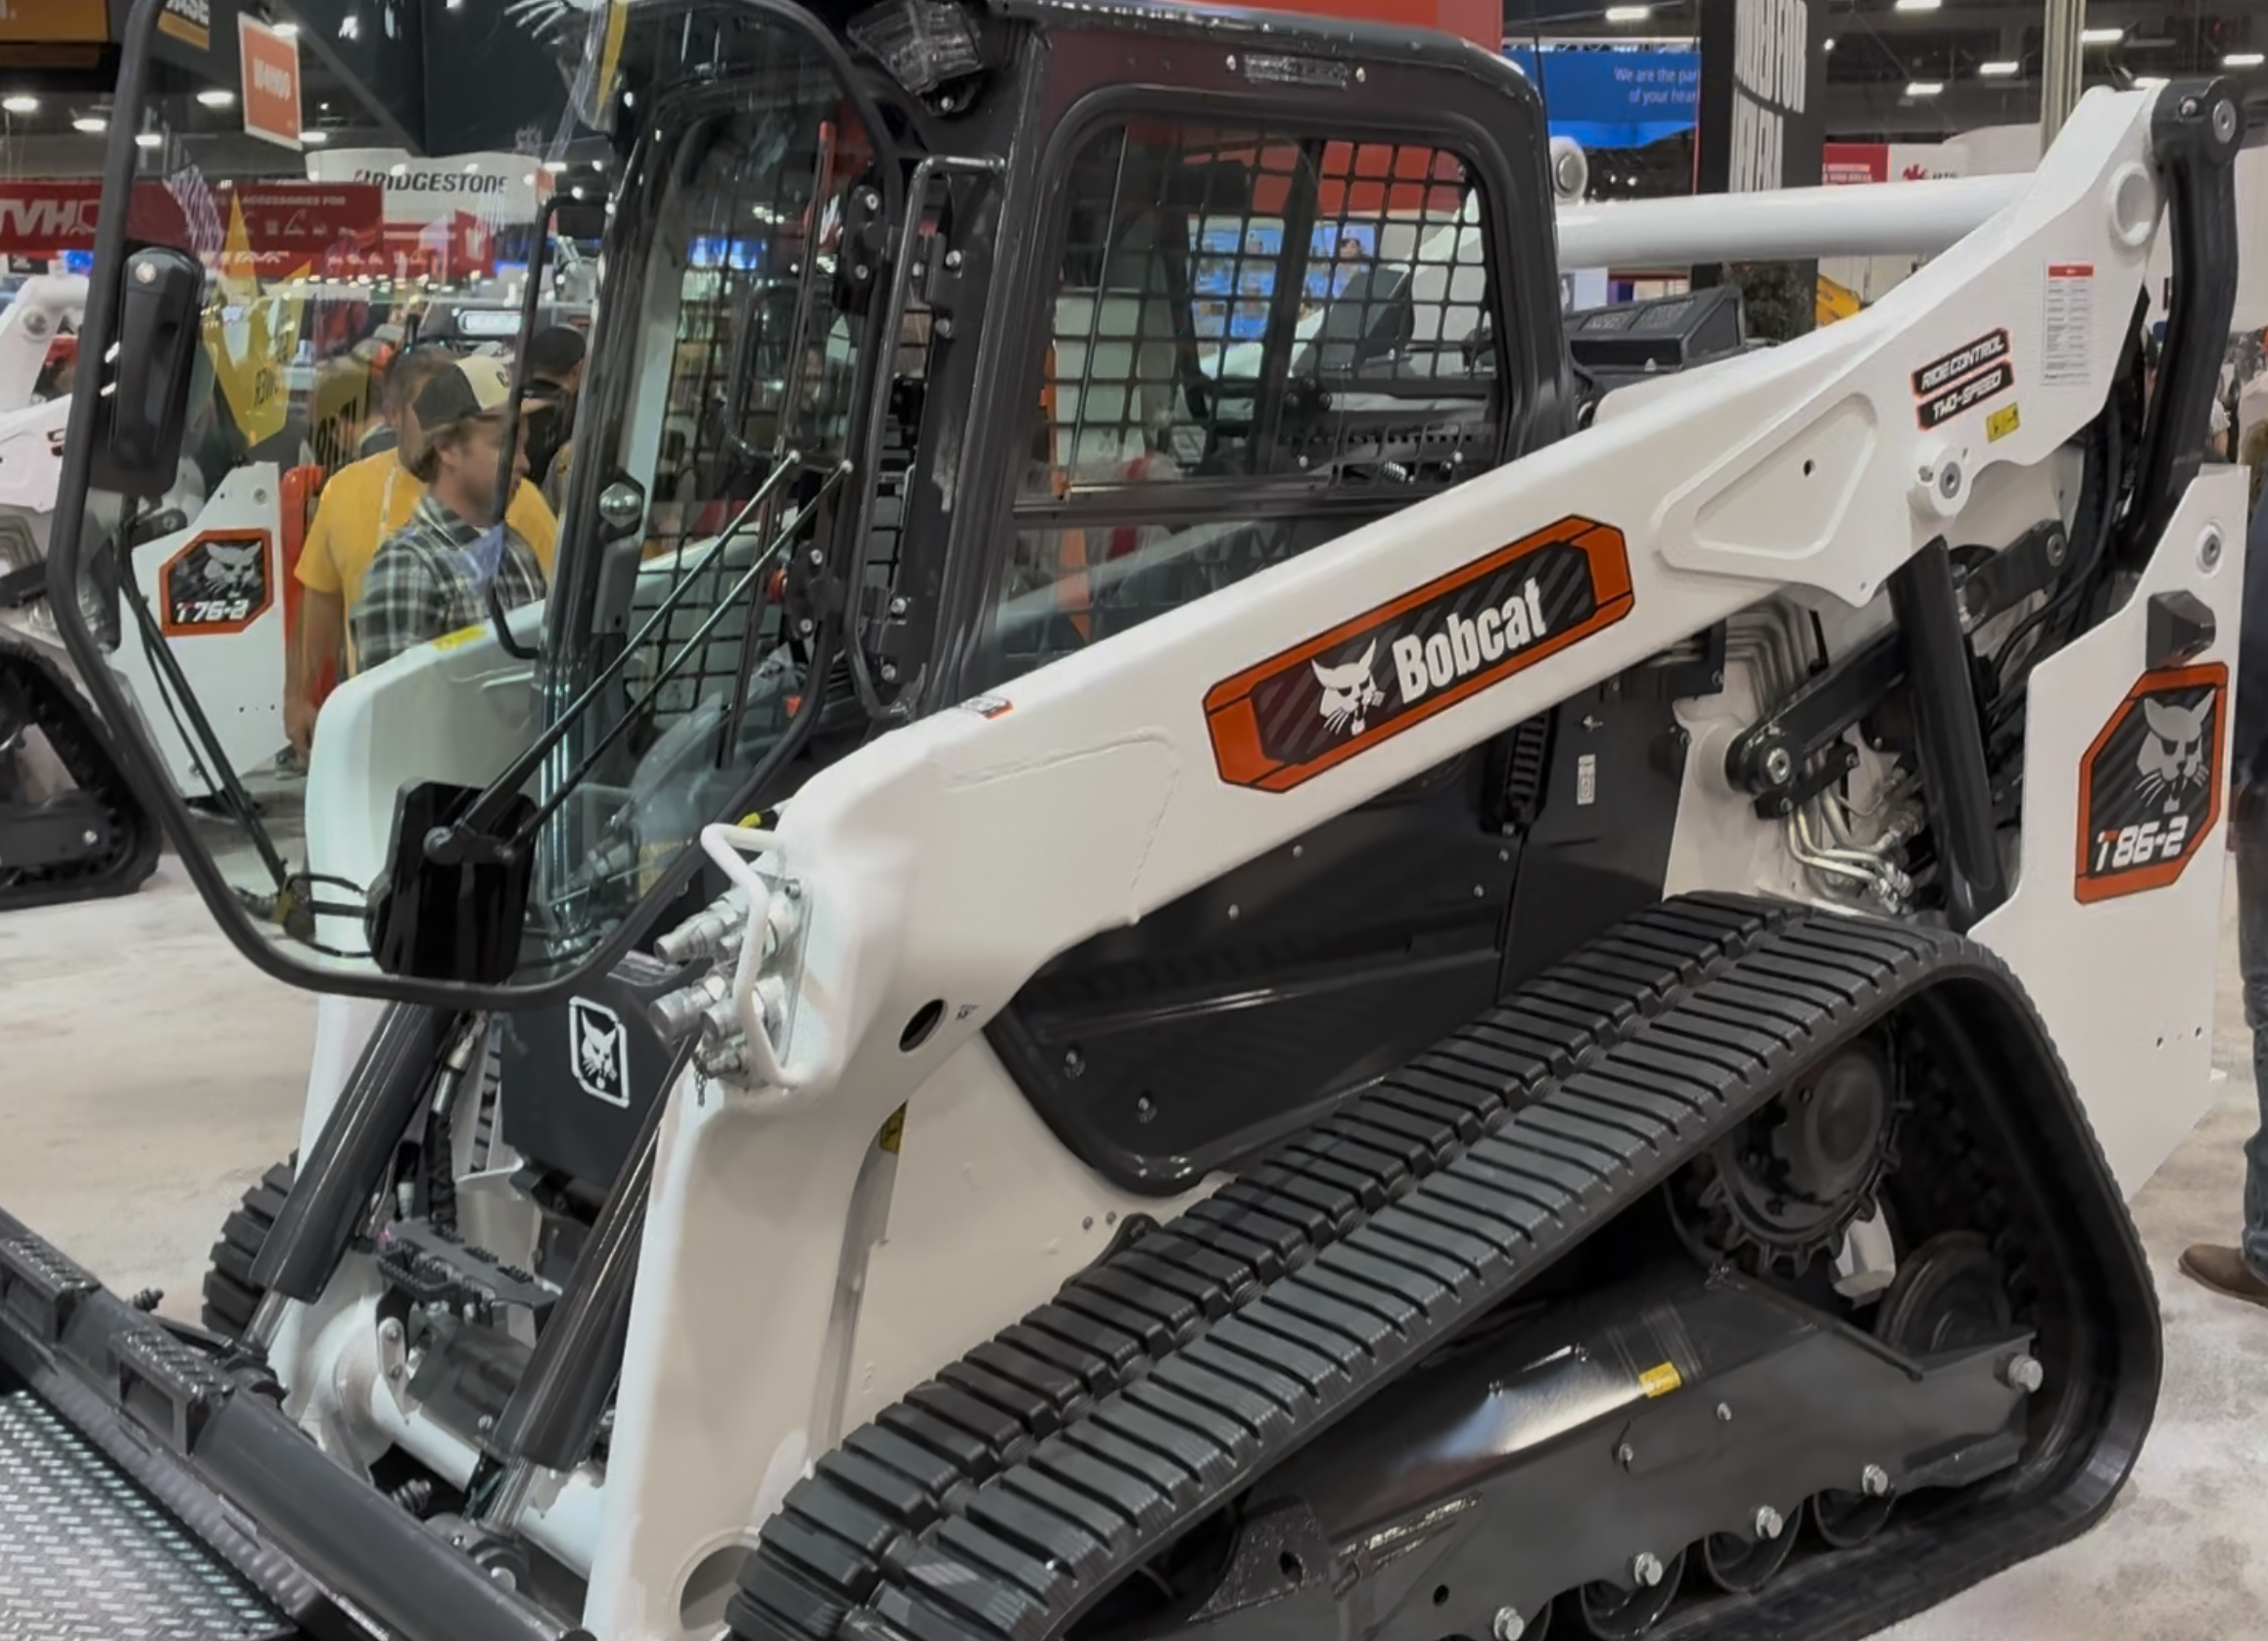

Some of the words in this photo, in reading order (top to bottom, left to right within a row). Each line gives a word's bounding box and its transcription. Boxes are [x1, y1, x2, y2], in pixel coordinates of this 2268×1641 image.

[1614, 66, 1633, 82] We
[1635, 69, 1655, 82] are
[1657, 67, 1677, 82] the
[1629, 86, 1641, 103] of
[1642, 90, 1668, 107] your
[1950, 335, 2005, 376] CONTROL
[1933, 368, 2003, 421] TWO-SPEED
[1392, 577, 1547, 704] Bobcat
[2095, 815, 2189, 872] T86-2
